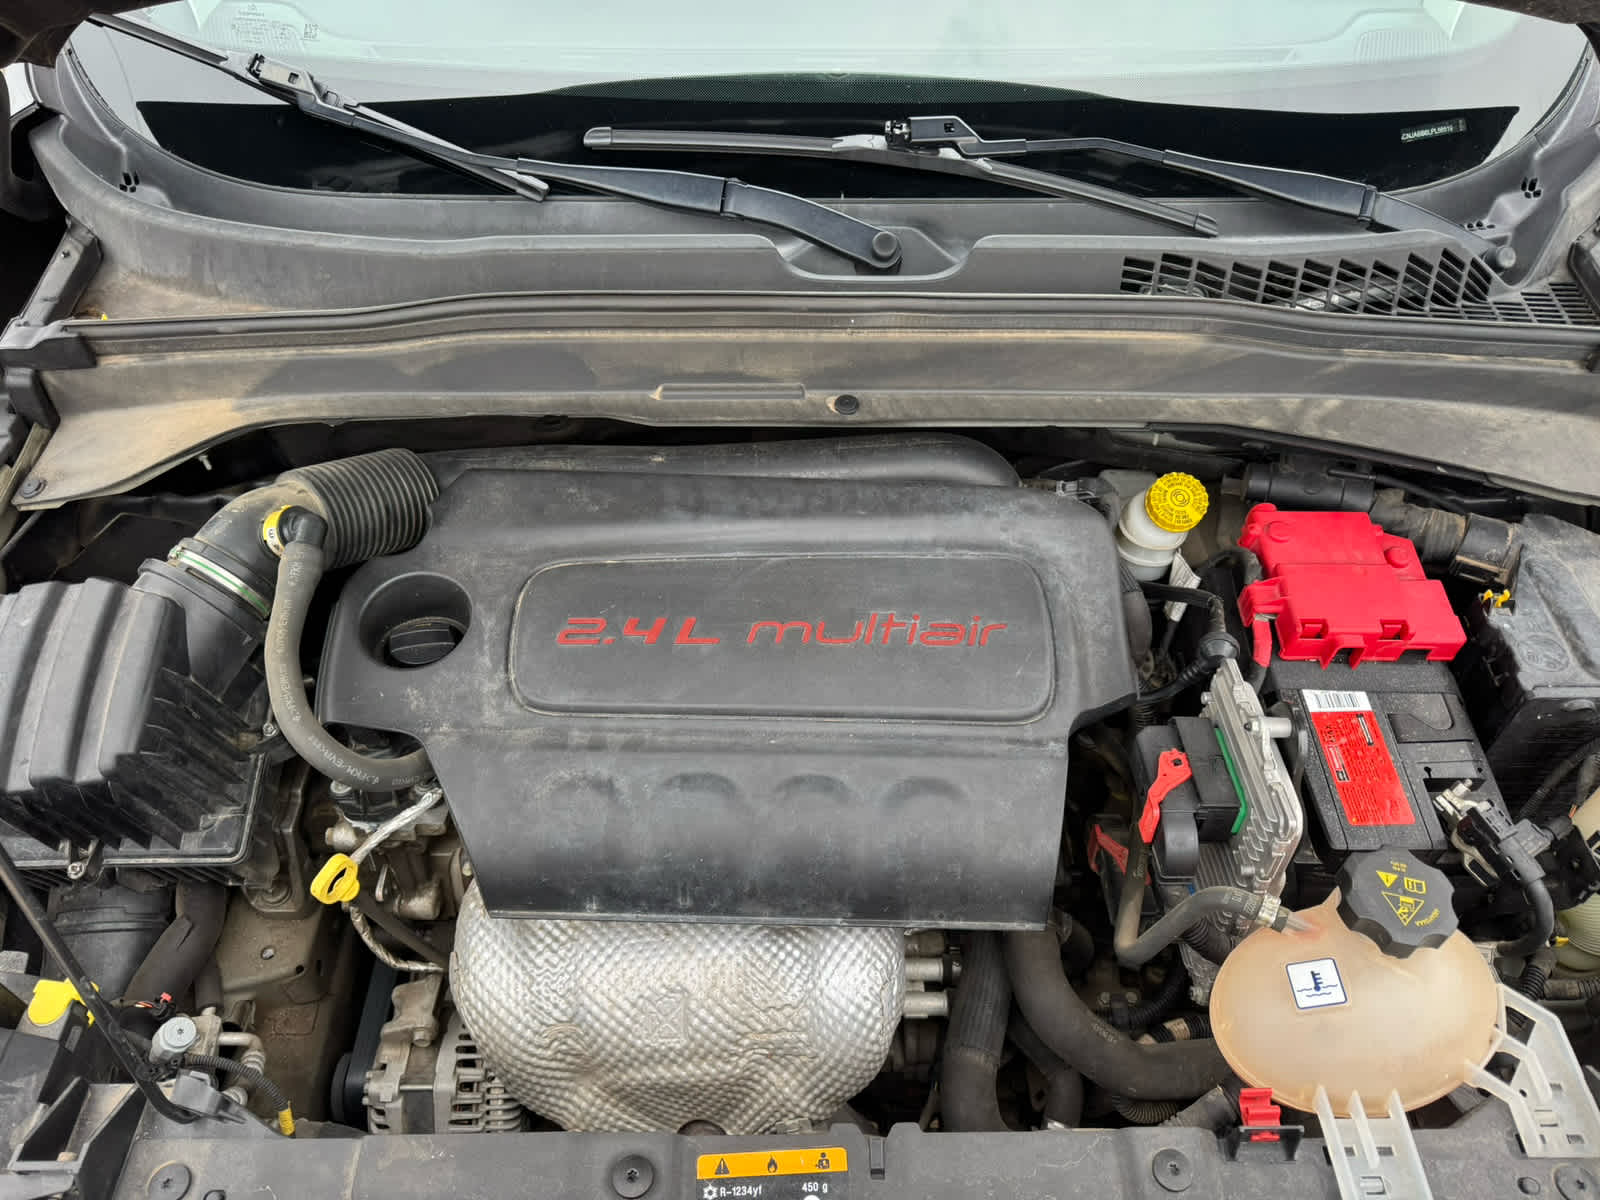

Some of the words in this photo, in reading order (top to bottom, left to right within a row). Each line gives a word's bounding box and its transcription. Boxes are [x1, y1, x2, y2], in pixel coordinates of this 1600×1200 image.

[746, 611, 1009, 647] multiair
[801, 1182, 819, 1192] 450
[822, 1183, 828, 1194] g
